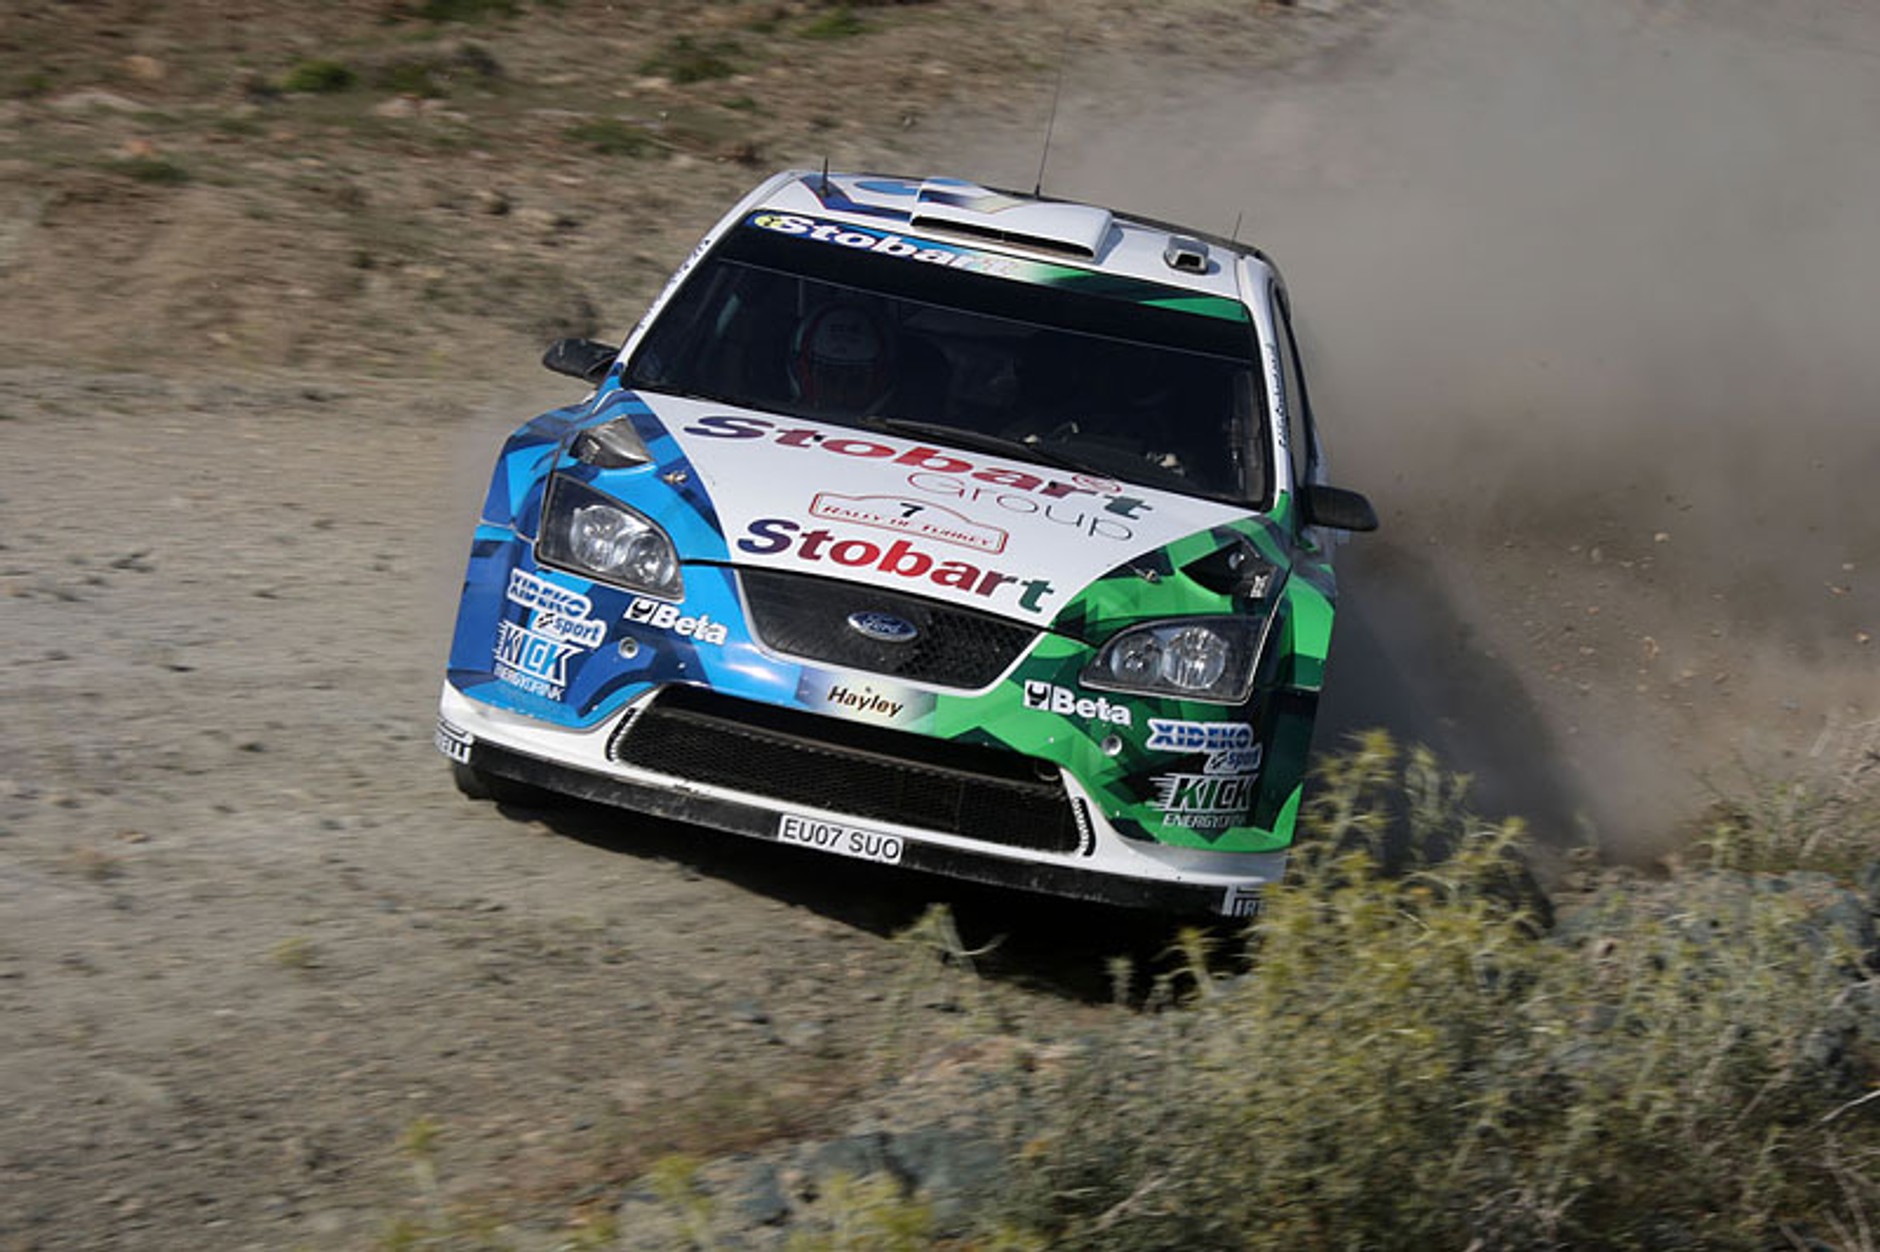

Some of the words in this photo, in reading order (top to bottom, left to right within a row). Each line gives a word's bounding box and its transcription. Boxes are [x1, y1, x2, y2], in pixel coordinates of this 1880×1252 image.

[774, 214, 1017, 274] Stobart
[684, 415, 1153, 520] Stobart
[900, 502, 924, 518] 7
[907, 471, 1132, 540] Group
[737, 518, 1056, 614] Stobart
[653, 601, 728, 646] Beta
[497, 621, 585, 687] KICK
[827, 685, 904, 718] Hayley
[1050, 685, 1131, 726] Beta
[1164, 774, 1258, 811] KICK
[782, 817, 843, 844] EU07
[848, 830, 900, 860] SUO
